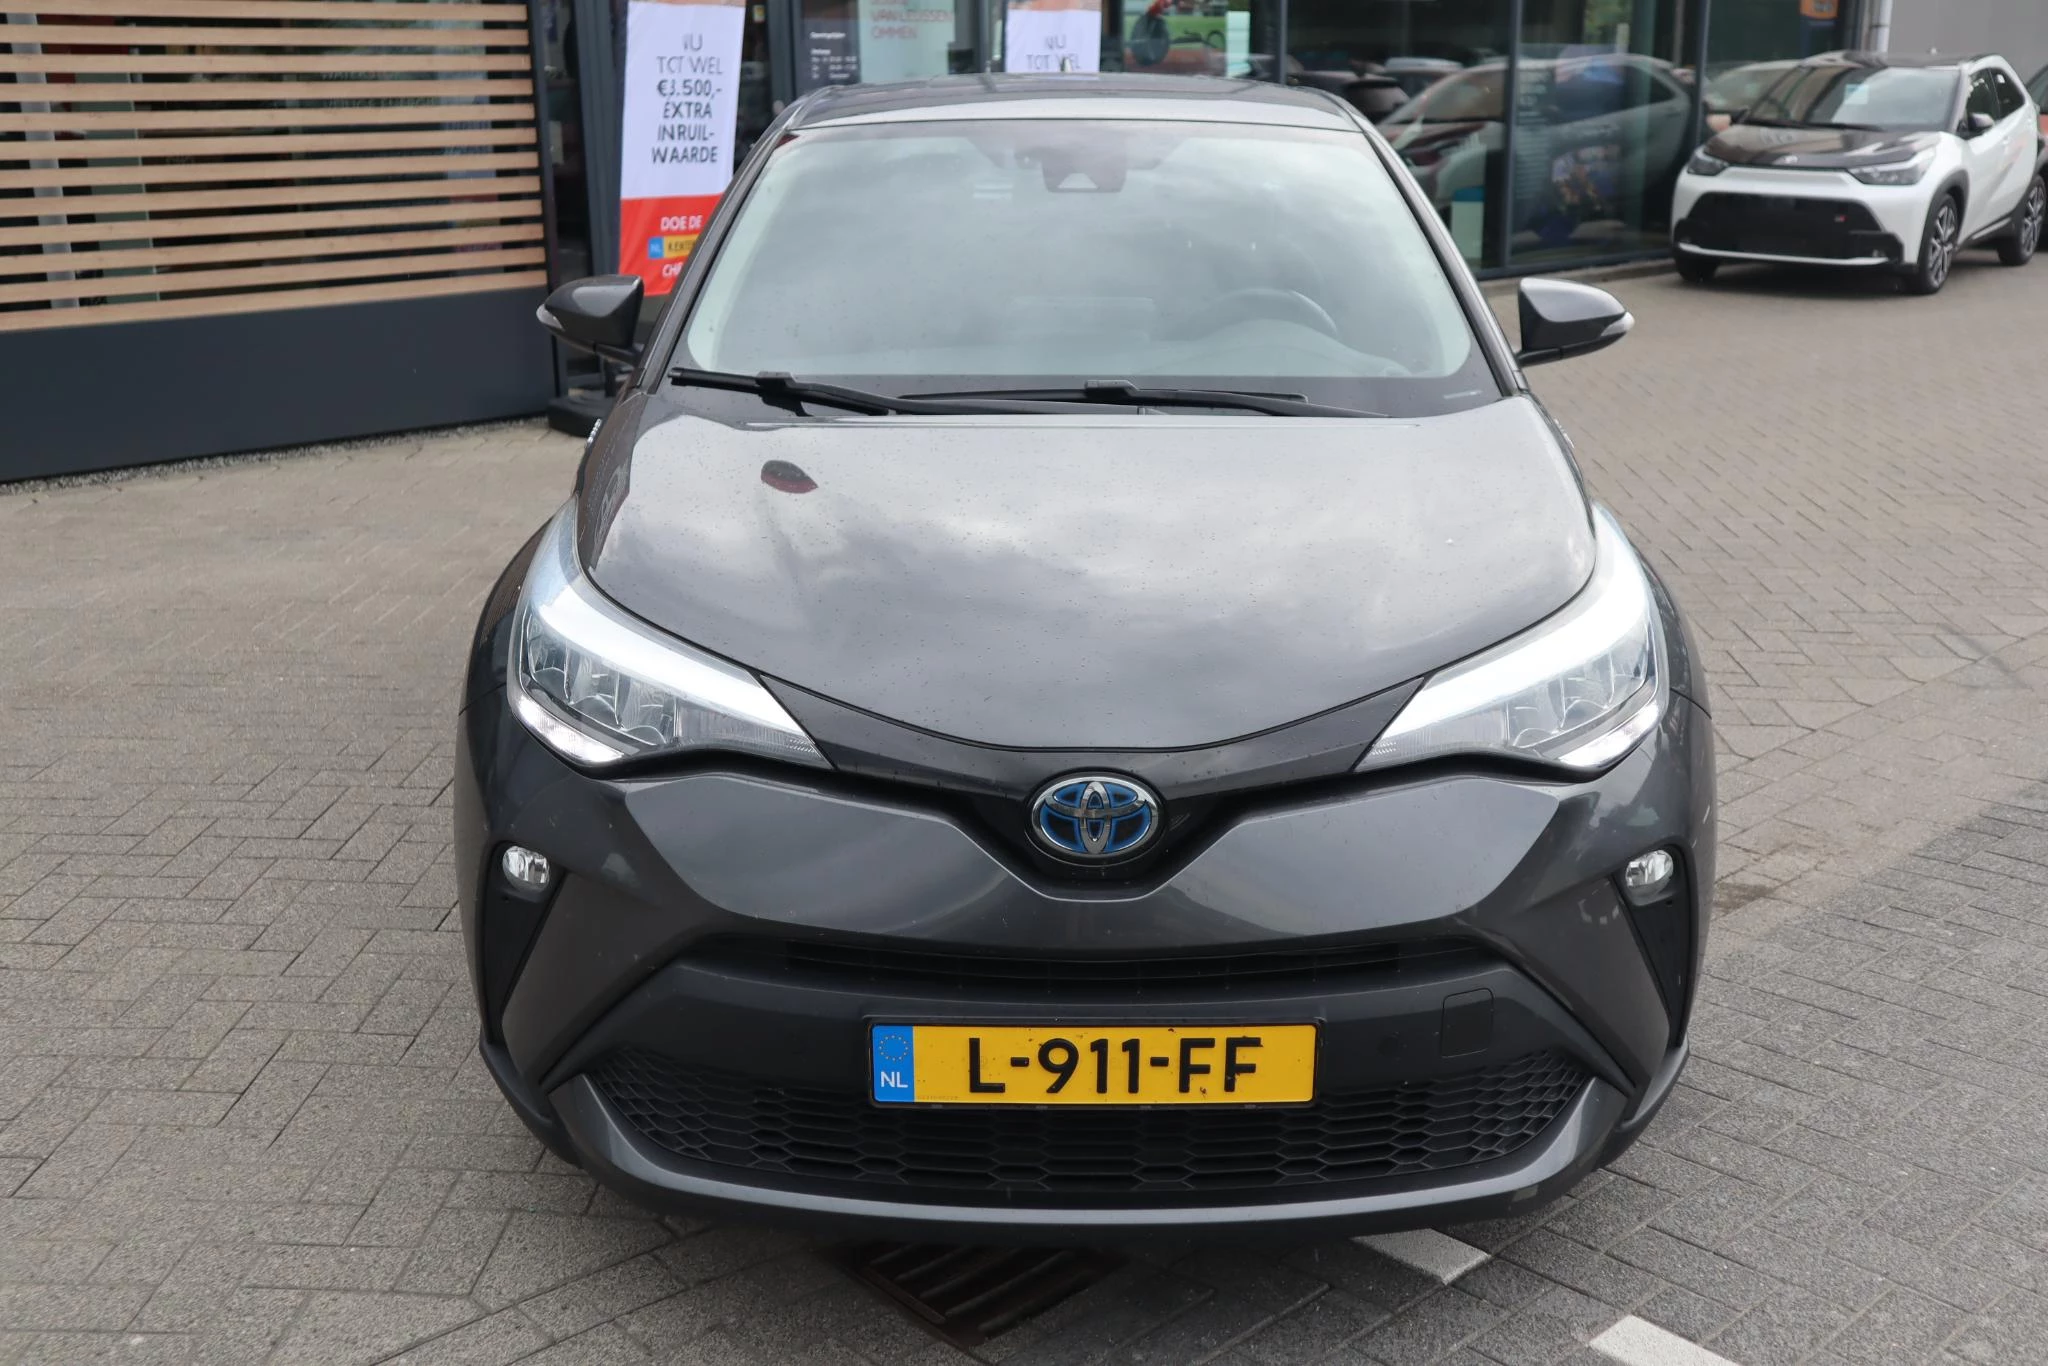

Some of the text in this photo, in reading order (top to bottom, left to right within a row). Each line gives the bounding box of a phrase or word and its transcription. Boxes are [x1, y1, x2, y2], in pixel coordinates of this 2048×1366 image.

[688, 55, 725, 74] WEL
[663, 101, 713, 119] EXTRA
[658, 124, 715, 141] INRUIL-
[651, 146, 718, 164] WAARDE
[660, 215, 703, 231] DOE DE
[880, 1036, 1264, 1094] NL L-911-FF
